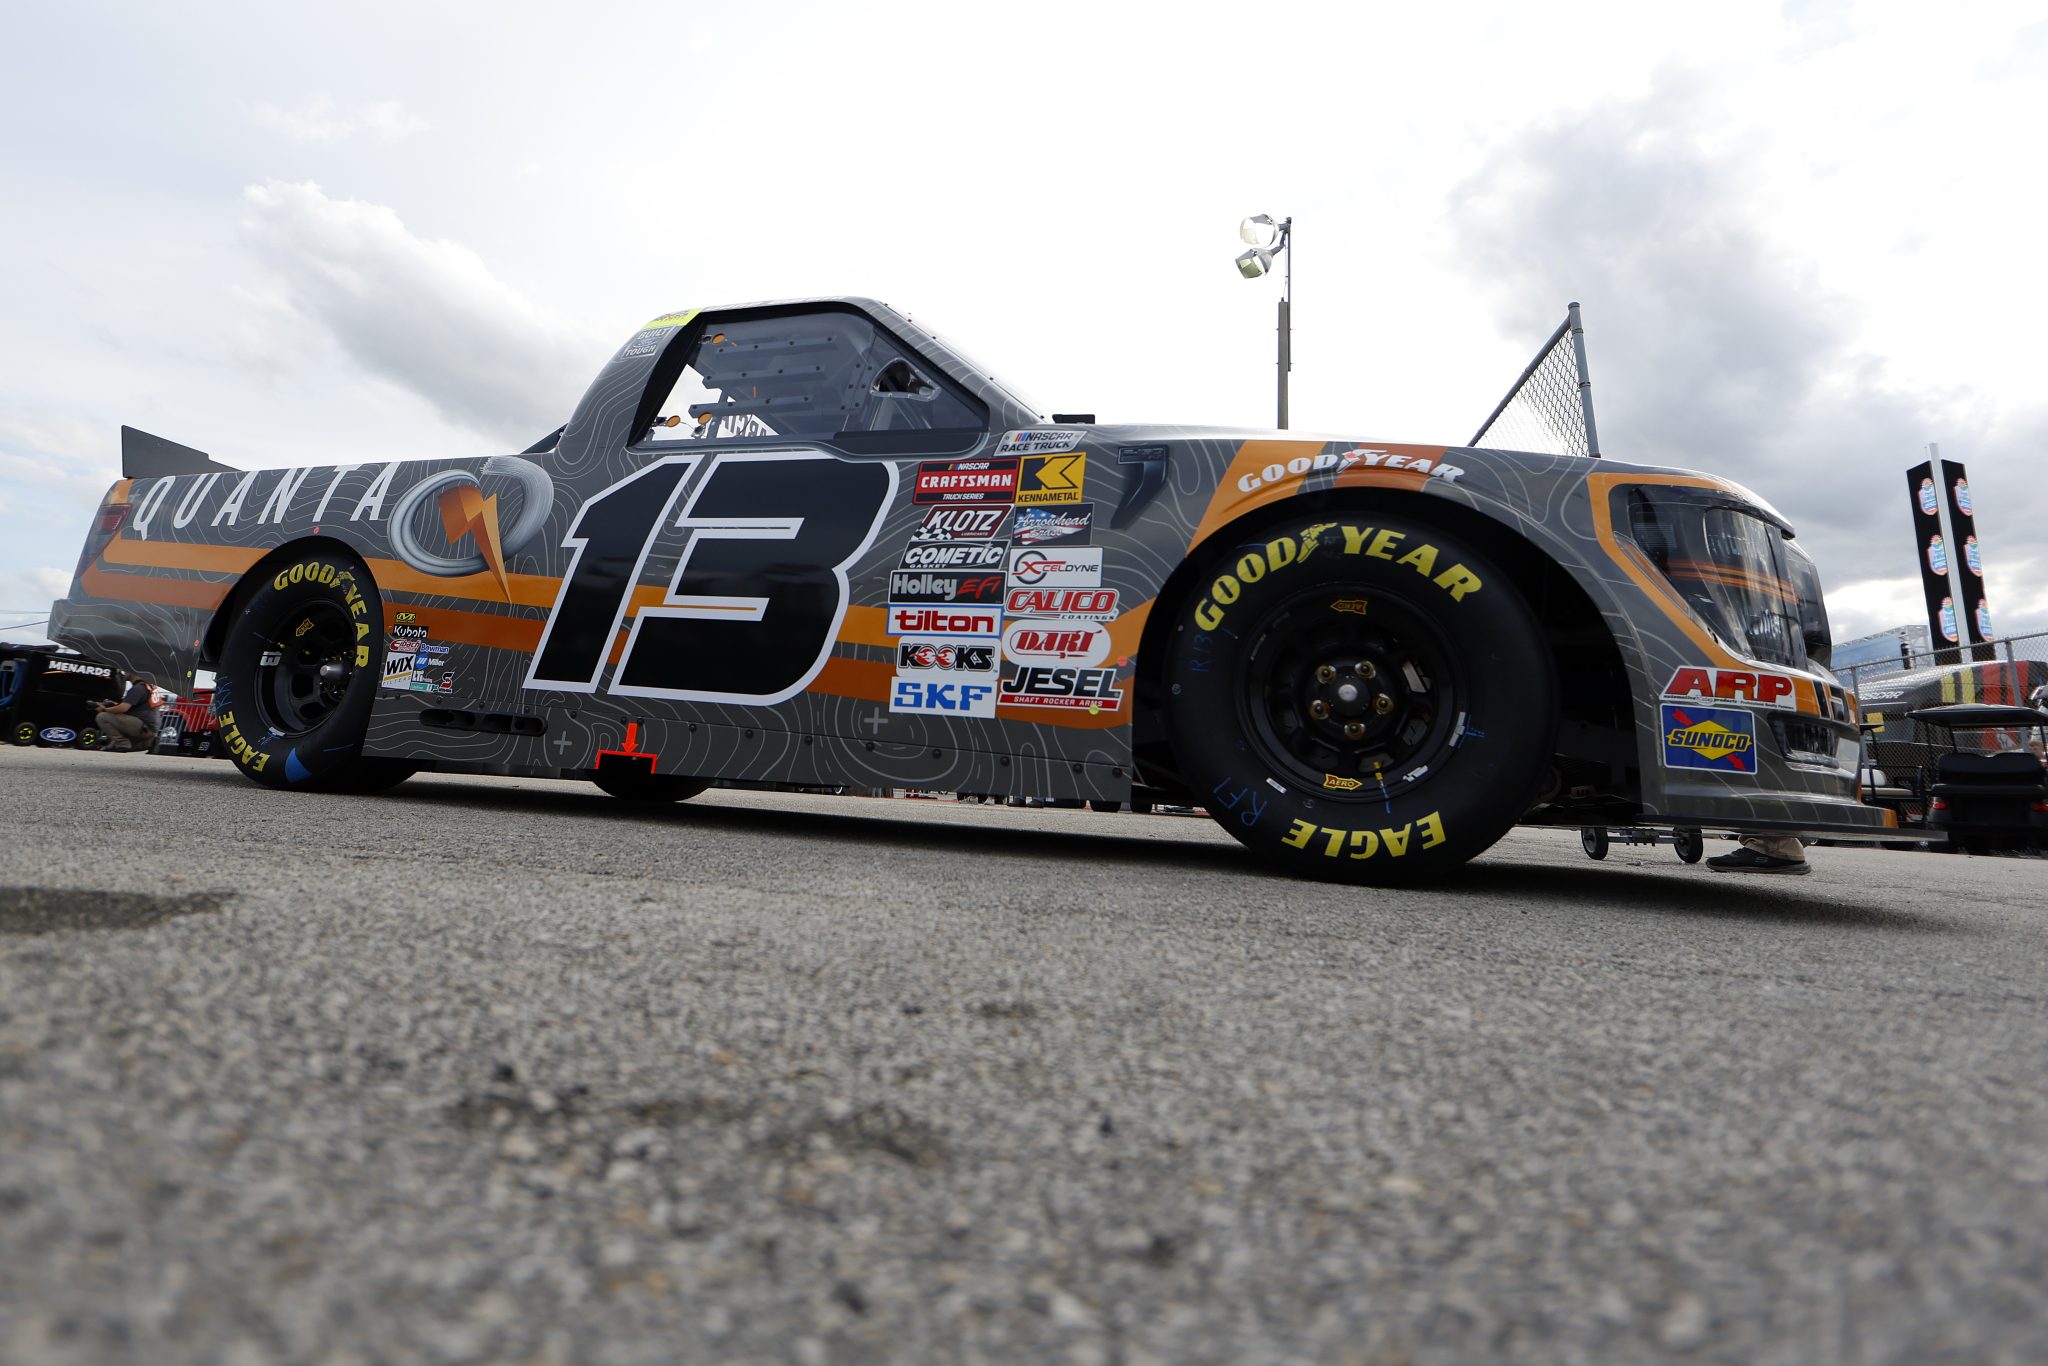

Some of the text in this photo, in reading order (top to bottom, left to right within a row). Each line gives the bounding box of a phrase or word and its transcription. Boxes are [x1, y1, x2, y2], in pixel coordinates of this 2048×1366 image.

[639, 328, 671, 339] BUILT
[626, 345, 656, 356] TOUGH
[1001, 440, 1072, 452] RACE TRUCK
[1027, 433, 1073, 441] NASCAR
[957, 463, 990, 471] NASCAR
[1237, 449, 1465, 492] GOODYEAR
[921, 474, 1012, 488] CRAFTSMAN
[133, 461, 403, 541] QUANTA
[1018, 491, 1079, 502] KENNAMETAL
[927, 510, 1002, 531] KLOTZ
[1014, 512, 1091, 528] Arrowhead
[1030, 528, 1062, 537] Brass
[905, 547, 1003, 564] COMETIC
[1012, 561, 1099, 575] XCELDYNE
[1194, 523, 1482, 631] GOODYEAR
[522, 451, 900, 706] 13
[892, 574, 957, 601] Holley
[1008, 591, 1117, 612] CALICO
[274, 562, 370, 668] GOODYEAR
[895, 610, 994, 632] tilton
[394, 626, 427, 637] Kubota
[1016, 629, 1101, 652] DART
[421, 643, 449, 653] Bowman
[387, 655, 414, 675] WIX
[428, 658, 444, 666] Miller
[899, 643, 995, 672] KOOKS
[48, 661, 111, 677] MENARDS
[1003, 667, 1114, 697] JESEL
[1664, 668, 1792, 703] ARP
[894, 682, 993, 711] SKF
[1014, 696, 1104, 708] SHAFT ROCKER ARMS
[47, 729, 71, 741] Ford
[218, 711, 271, 772] EAGLE
[1671, 730, 1749, 751] SUNOCO
[1328, 779, 1355, 788] AERO
[1281, 811, 1446, 860] EAGLE
